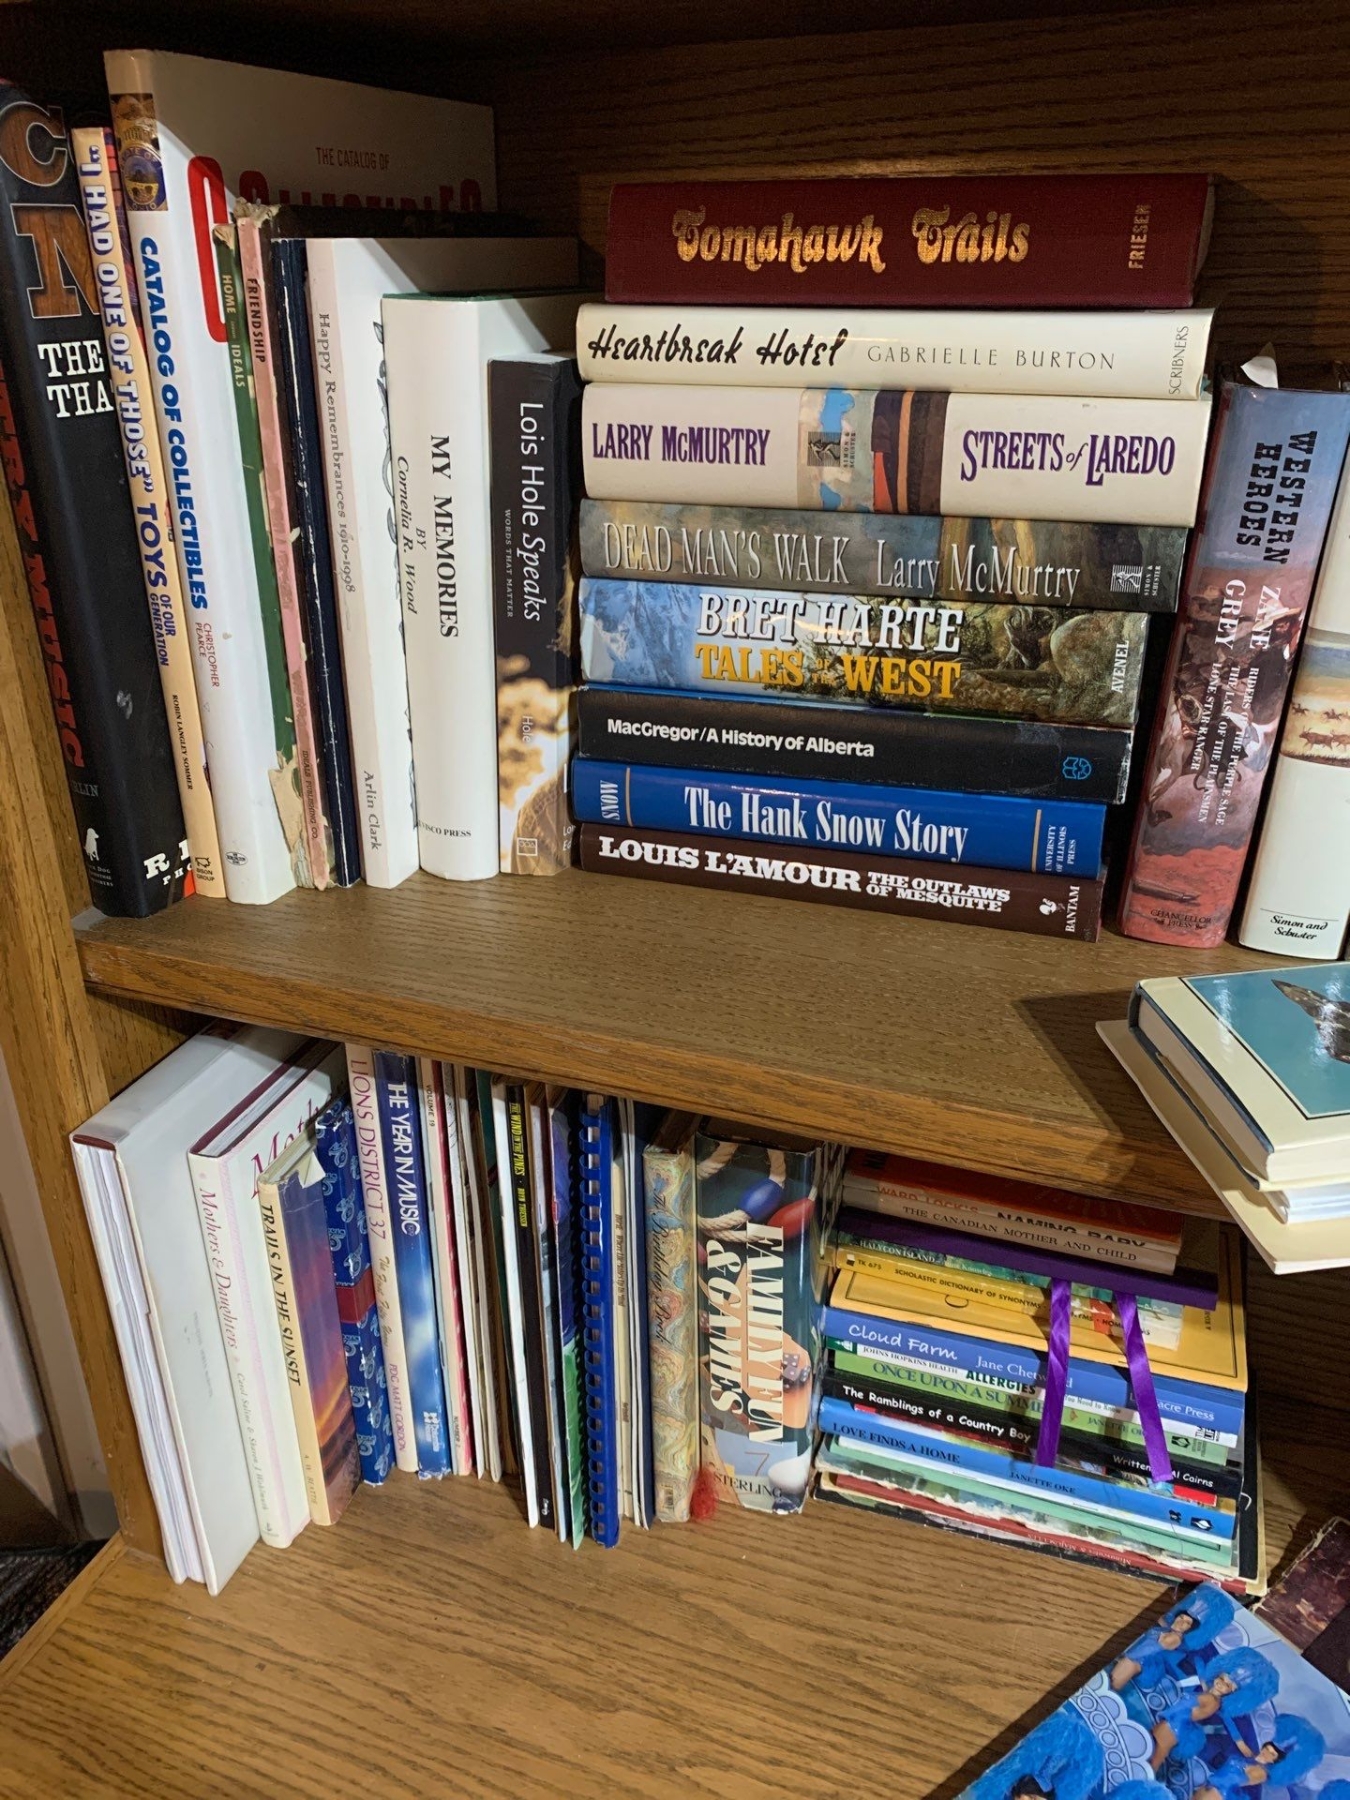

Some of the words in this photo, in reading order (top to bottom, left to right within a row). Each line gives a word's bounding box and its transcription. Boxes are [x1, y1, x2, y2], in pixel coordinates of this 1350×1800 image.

[316, 147, 335, 165] THE
[337, 149, 377, 170] CATALOG
[379, 152, 390, 171] OF
[84, 185, 114, 256] HAD
[672, 204, 886, 273] Tomahawk
[911, 204, 1031, 264] Trails
[97, 262, 127, 328] ONE
[140, 236, 175, 378] CATALOG
[222, 274, 236, 314] HOME
[231, 344, 245, 388] IDEALS
[247, 278, 266, 363] FRIENDSHIP
[37, 339, 105, 378] THE
[108, 331, 134, 375] OF
[588, 323, 744, 364] Heartbreak
[756, 327, 849, 367] Hotel
[867, 345, 998, 366] GABRIELLE
[1015, 350, 1115, 370] BURTON
[1168, 325, 1190, 396] SCRIBNERS
[161, 383, 182, 423] OF
[519, 402, 546, 456] Lois
[592, 422, 653, 461] LARRY
[661, 424, 771, 466] McMURTRY
[316, 313, 332, 374] Happy
[325, 381, 345, 518] Remembrances
[339, 523, 355, 593] 1910-1998
[431, 435, 452, 480] MY
[961, 429, 1065, 482] STREETS
[1066, 442, 1088, 472] of
[1085, 434, 1176, 486] LAREDO
[397, 455, 412, 530] Cornelia
[521, 465, 546, 527] Hole
[1236, 442, 1284, 546] HEROES
[1263, 430, 1318, 564] WESTERN
[167, 428, 208, 610] COLLECTIBLES
[415, 527, 427, 550] BY
[503, 509, 512, 546] WORDS
[136, 503, 168, 588] TOYS
[433, 495, 459, 638] MEMORIES
[505, 548, 513, 576] THAT
[603, 522, 674, 573] DEAD
[681, 527, 762, 579] MAN’S
[773, 533, 850, 585] WALK
[875, 539, 941, 597] Larry
[949, 543, 1081, 606] McMurtry
[404, 563, 417, 615] Wood
[517, 532, 547, 622] Speaks
[159, 594, 172, 613] OF
[161, 613, 177, 637] OUR
[697, 592, 807, 645] BRET
[814, 601, 964, 653] HARTE
[1215, 578, 1246, 650] GREY
[149, 593, 169, 667] GENERATION
[195, 622, 206, 657] PEARCE
[202, 622, 220, 688] CHRISTOPHER
[695, 643, 804, 688] TALES
[840, 653, 962, 699] WEST
[1111, 639, 1130, 693] AVENEL
[1206, 663, 1222, 695] LONE
[1227, 666, 1240, 690] THE
[1241, 667, 1259, 712] RIDERS
[521, 715, 534, 744] Hole
[1200, 696, 1215, 724] STAR
[1217, 721, 1227, 737] OF
[172, 694, 181, 720] ROBIN
[182, 756, 194, 790] SOMMER
[721, 729, 784, 752] History
[784, 735, 804, 751] of
[805, 736, 875, 758] Alberta
[1190, 727, 1208, 771] RANGER
[1210, 740, 1224, 763] THE
[363, 769, 378, 809] Arlin
[1198, 764, 1218, 824] PLAINSMEN
[1222, 754, 1240, 797] PURPLE
[599, 780, 621, 821] SNOW
[1215, 797, 1230, 827] SAGE
[367, 813, 383, 850] Clark
[443, 828, 471, 837] PRESS
[684, 785, 732, 831] The
[741, 791, 808, 840] Hank
[815, 799, 886, 849] Snow
[894, 808, 968, 863] Story
[1056, 826, 1068, 862] ILLINOIS
[598, 836, 700, 869] LOUIS
[1044, 824, 1057, 872] UNIVERSITY
[1067, 839, 1077, 865] PRESS
[865, 883, 894, 898] OF
[896, 886, 1002, 912] MESQUITE
[867, 870, 909, 889] THE
[911, 877, 1011, 902] OUTLAWS
[1064, 885, 1081, 933] BANTAM
[1150, 908, 1213, 925] CHANCELLOR
[1270, 914, 1304, 929] Simon
[1305, 919, 1329, 931] and
[350, 1059, 374, 1124] LIONS
[387, 1081, 409, 1110] THE
[425, 1084, 436, 1118] VOLUME
[390, 1113, 413, 1154] YEAR
[510, 1114, 523, 1136] WIND
[358, 1126, 385, 1215] DISTRICT
[395, 1157, 415, 1174] IN
[513, 1152, 526, 1177] PINES
[395, 1174, 421, 1236] MUSIC
[261, 1204, 281, 1260] TRAILS
[368, 1218, 387, 1240] 37
[902, 1205, 928, 1219] THE
[933, 1212, 998, 1232] CANADIAN
[1003, 1227, 1058, 1246] MOTHER
[1063, 1240, 1091, 1252] AND
[1096, 1246, 1137, 1262] CHILD
[199, 1188, 222, 1254] Mothers
[215, 1271, 238, 1350] Daughters
[270, 1264, 285, 1286] IN
[706, 1239, 742, 1276] &
[275, 1290, 290, 1323] THE
[746, 1222, 784, 1373] FAMILY
[894, 1267, 938, 1284] SCHOLASTIC
[938, 1278, 984, 1295] DICTIONARY
[985, 1290, 997, 1298] OF
[998, 1293, 1041, 1310] SYNONYMS
[282, 1327, 301, 1387] SUNSET
[707, 1277, 744, 1415] GAMES
[848, 1322, 902, 1348] Cloud
[908, 1338, 958, 1361] Farm
[975, 1355, 1004, 1372] Jane
[862, 1346, 889, 1358] JOHNS
[891, 1353, 927, 1367] HOPKINS
[928, 1362, 958, 1374] HEALTH
[873, 1361, 917, 1383] ONCE
[920, 1372, 967, 1395] UPON
[969, 1385, 983, 1398] A
[965, 1369, 1037, 1395] ALLERGIES
[746, 1376, 784, 1447] FUN
[843, 1385, 865, 1400] The
[869, 1391, 924, 1417] Ramblings
[928, 1408, 943, 1418] of
[946, 1413, 954, 1423] a
[958, 1415, 1004, 1436] Country
[1009, 1427, 1032, 1444] Boy
[1185, 1405, 1215, 1421] Press
[832, 1422, 866, 1440] LOVE
[869, 1432, 906, 1450] FINDS
[907, 1441, 917, 1453] A
[919, 1445, 960, 1464] HOME
[1009, 1471, 1054, 1489] JANETTE
[1054, 1483, 1077, 1496] OKE
[1112, 1454, 1151, 1472] Written
[1182, 1473, 1214, 1488] Cairns
[713, 1471, 783, 1499] STERLING
